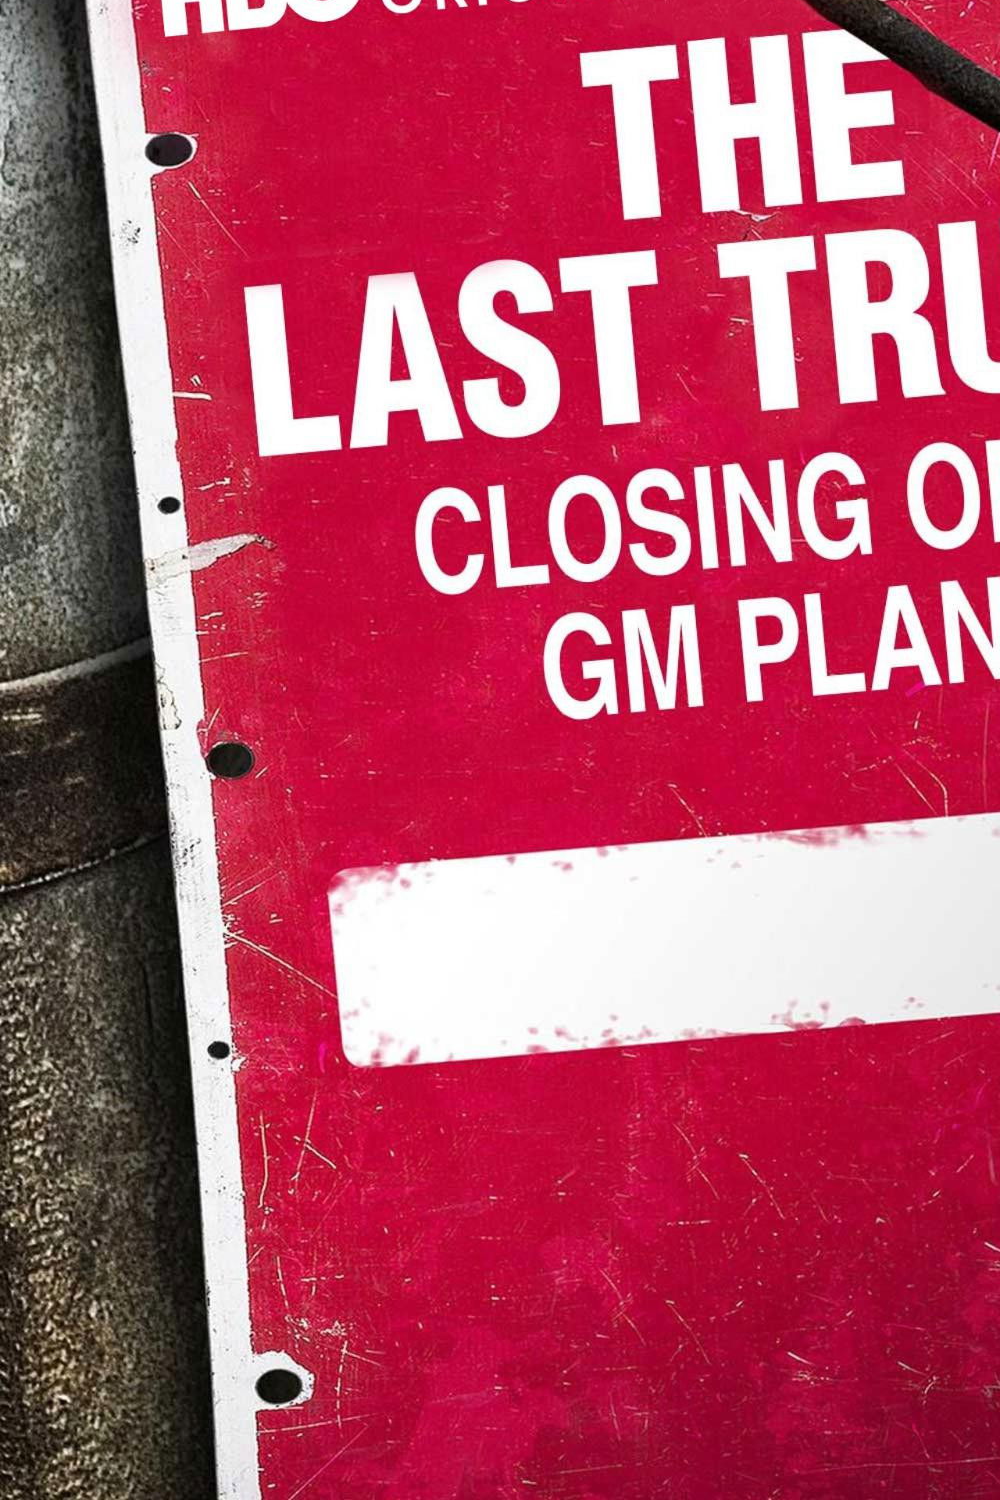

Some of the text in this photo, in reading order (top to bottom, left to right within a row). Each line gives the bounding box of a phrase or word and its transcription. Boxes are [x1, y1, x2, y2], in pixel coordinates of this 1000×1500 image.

[579, 29, 906, 220] THE
[243, 249, 658, 457] LAST
[415, 452, 873, 595] CLOSING
[543, 604, 704, 720] GM
